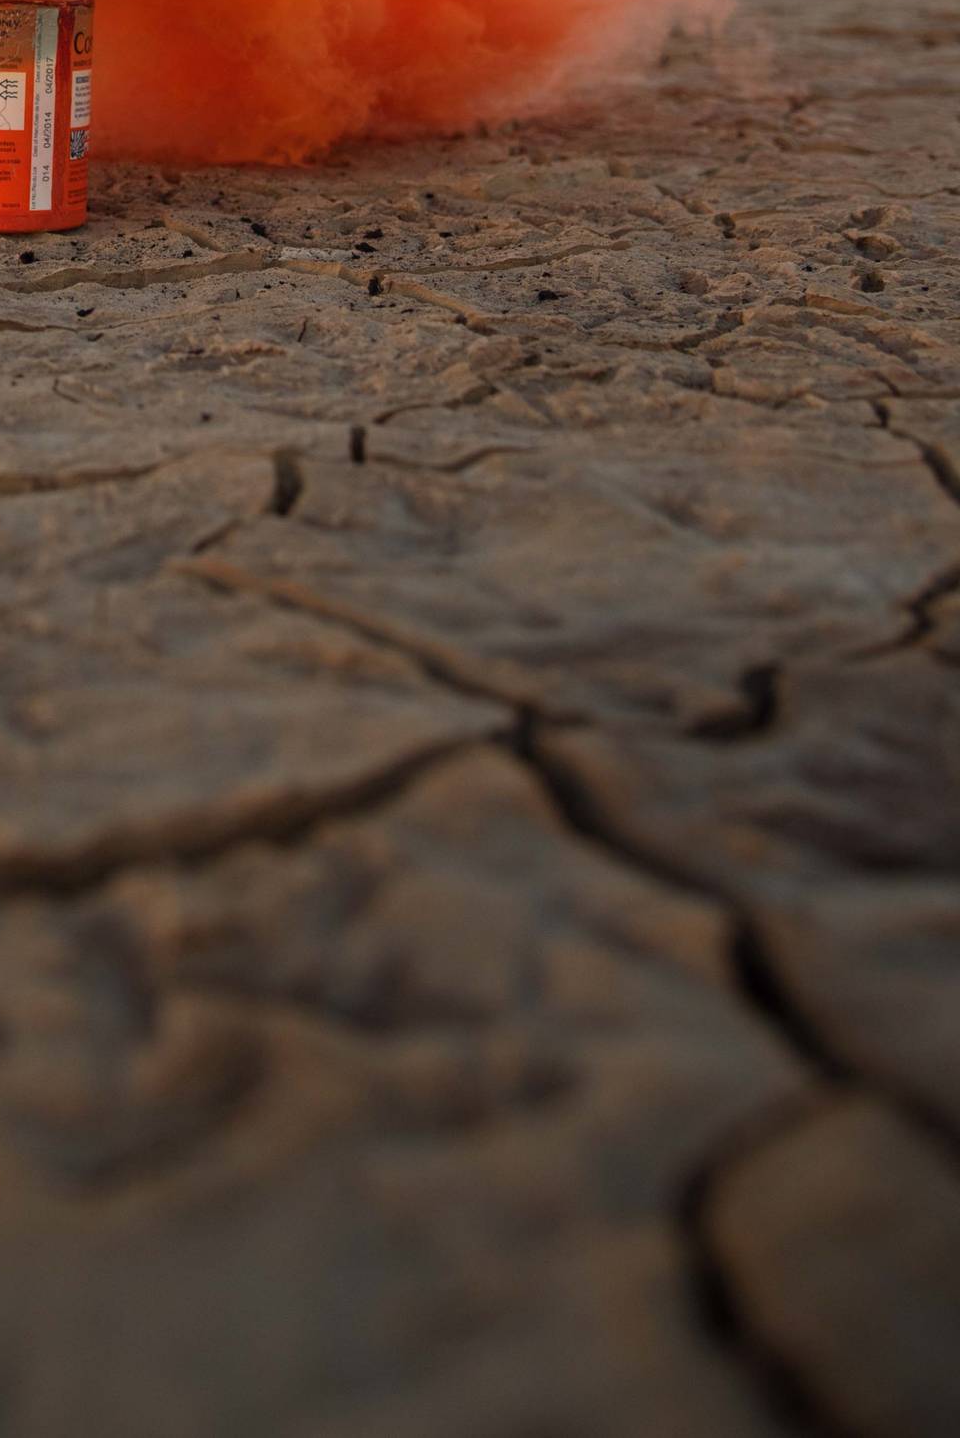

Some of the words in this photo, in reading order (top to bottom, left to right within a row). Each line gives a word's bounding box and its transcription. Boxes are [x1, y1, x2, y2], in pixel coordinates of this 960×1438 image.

[45, 57, 54, 95] 04/2017
[44, 111, 52, 149] 04/2014
[42, 165, 50, 182] 014
